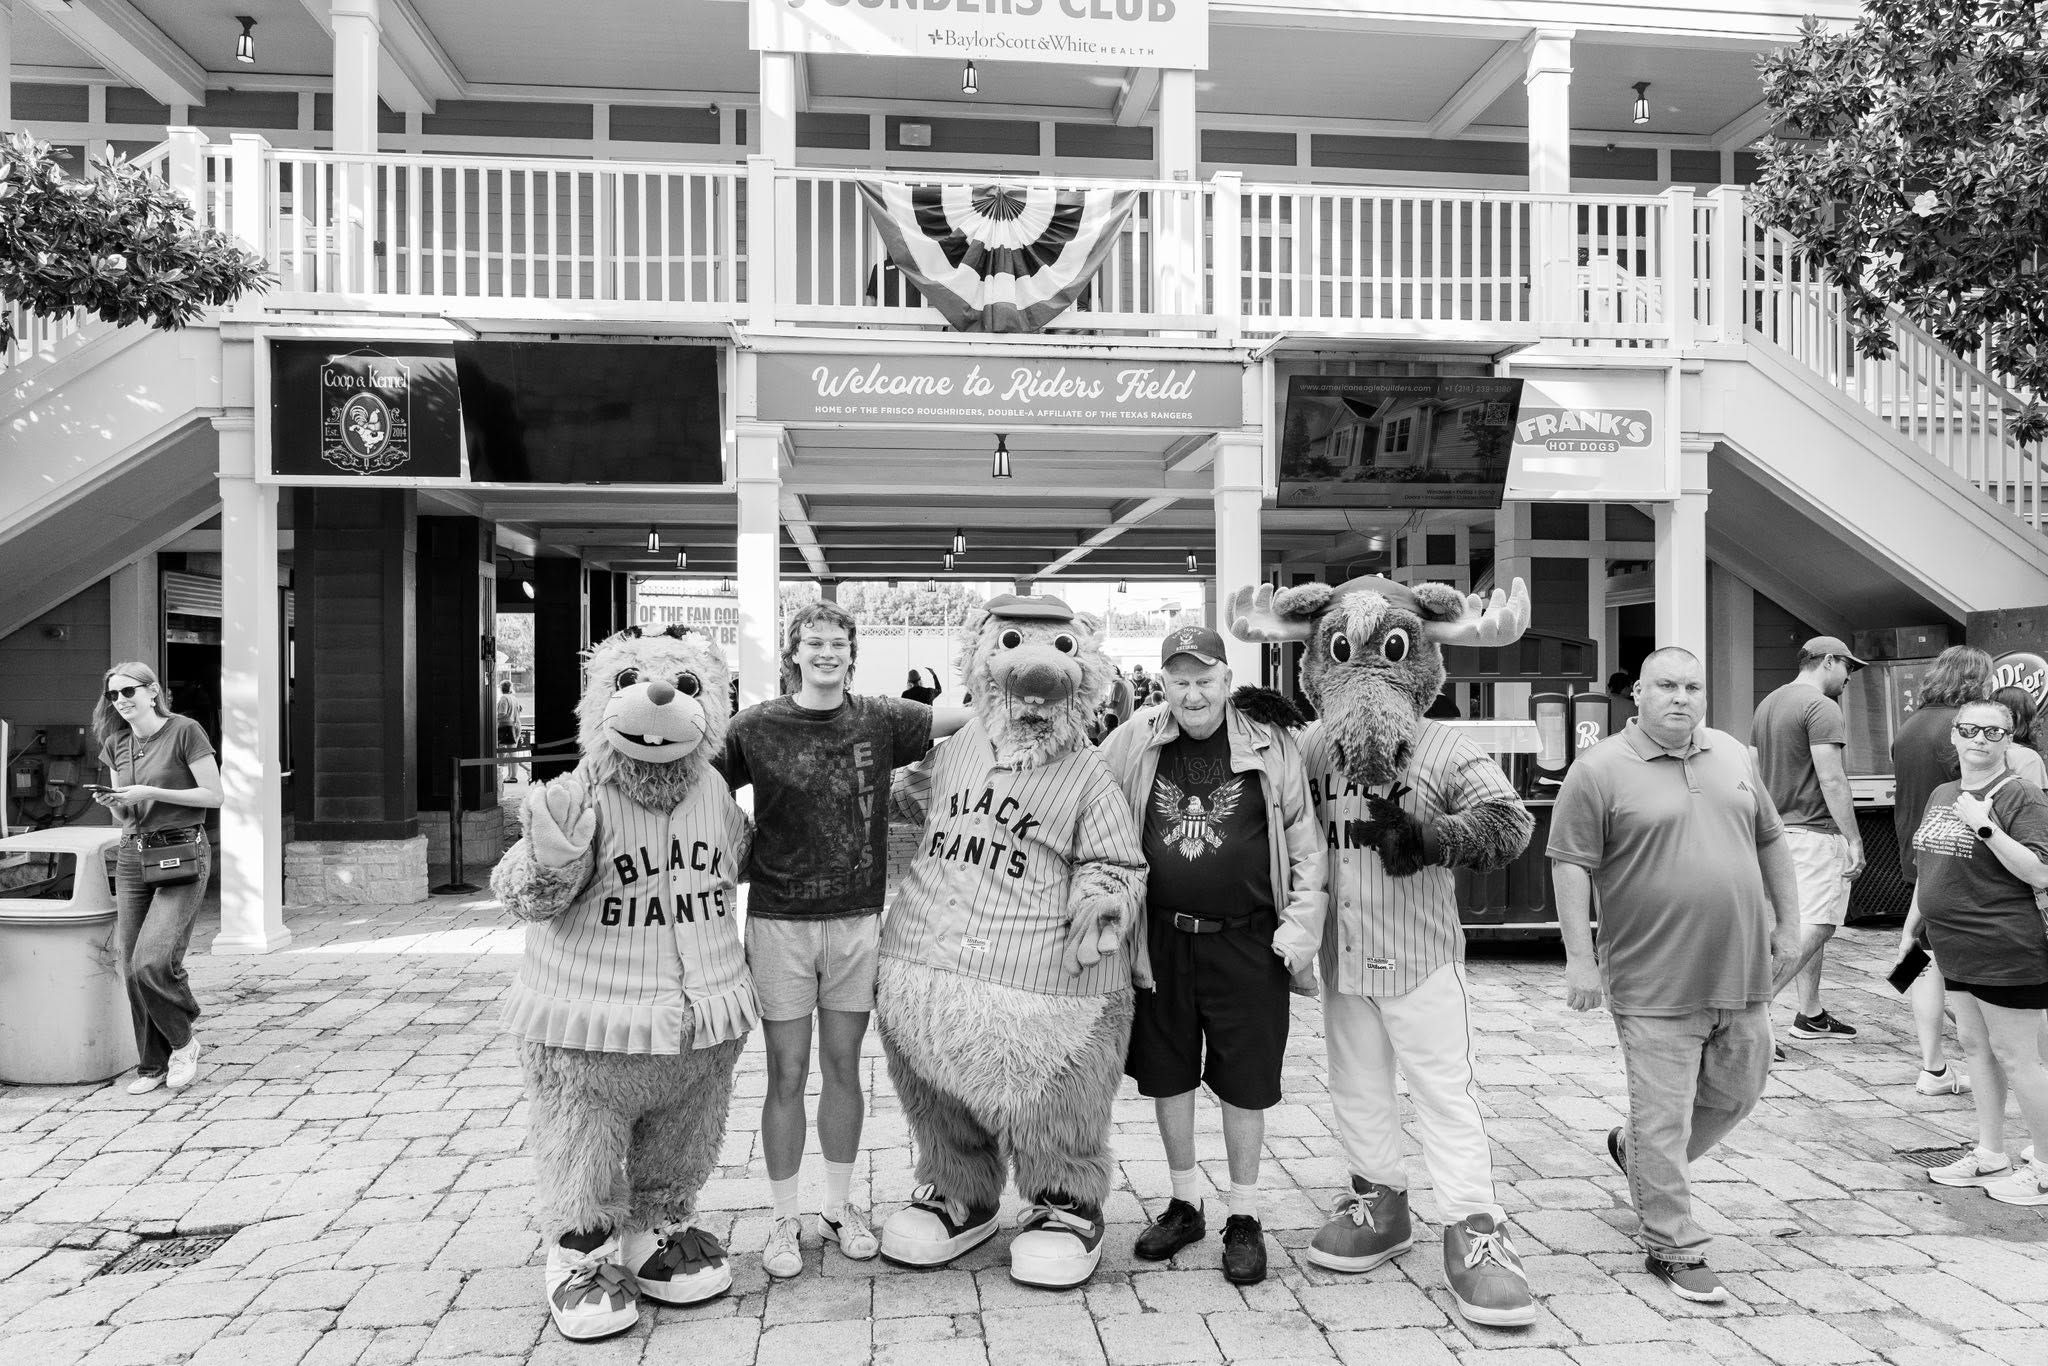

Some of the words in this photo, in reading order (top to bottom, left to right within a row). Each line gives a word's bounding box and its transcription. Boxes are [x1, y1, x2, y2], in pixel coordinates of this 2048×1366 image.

[1100, 46, 1155, 56] HEALTH
[324, 368, 354, 391] Coop
[367, 364, 407, 389] Kennel
[811, 362, 954, 397] Welcome
[962, 364, 995, 396] to
[1000, 366, 1105, 403] Riders
[1116, 368, 1197, 403] Field
[815, 405, 842, 414] HOME
[845, 406, 858, 414] OF
[860, 406, 879, 415] THE
[881, 407, 915, 415] FRISCO
[917, 408, 985, 417] ROUGHRIDERS,
[987, 409, 1034, 417] DOUBLE-A
[1036, 410, 1082, 418] AFFILIATE
[1085, 410, 1098, 419] OF
[1100, 411, 1118, 419] THE
[1120, 411, 1149, 419] TEXAS
[1151, 412, 1193, 420] RANGERS
[392, 427, 407, 438] 2014
[1517, 411, 1647, 443] FRANK'S
[1550, 442, 1575, 451] HOT
[1580, 442, 1615, 452] DOGS
[640, 606, 656, 622] OF
[659, 606, 683, 624] THE
[687, 607, 711, 624] FAN
[721, 627, 736, 644] BE
[1172, 757, 1227, 785] USA
[951, 787, 1041, 841] BLACK
[613, 839, 722, 886] BLACK
[929, 831, 1027, 879] GIANTS
[600, 889, 726, 927] GIANTS
